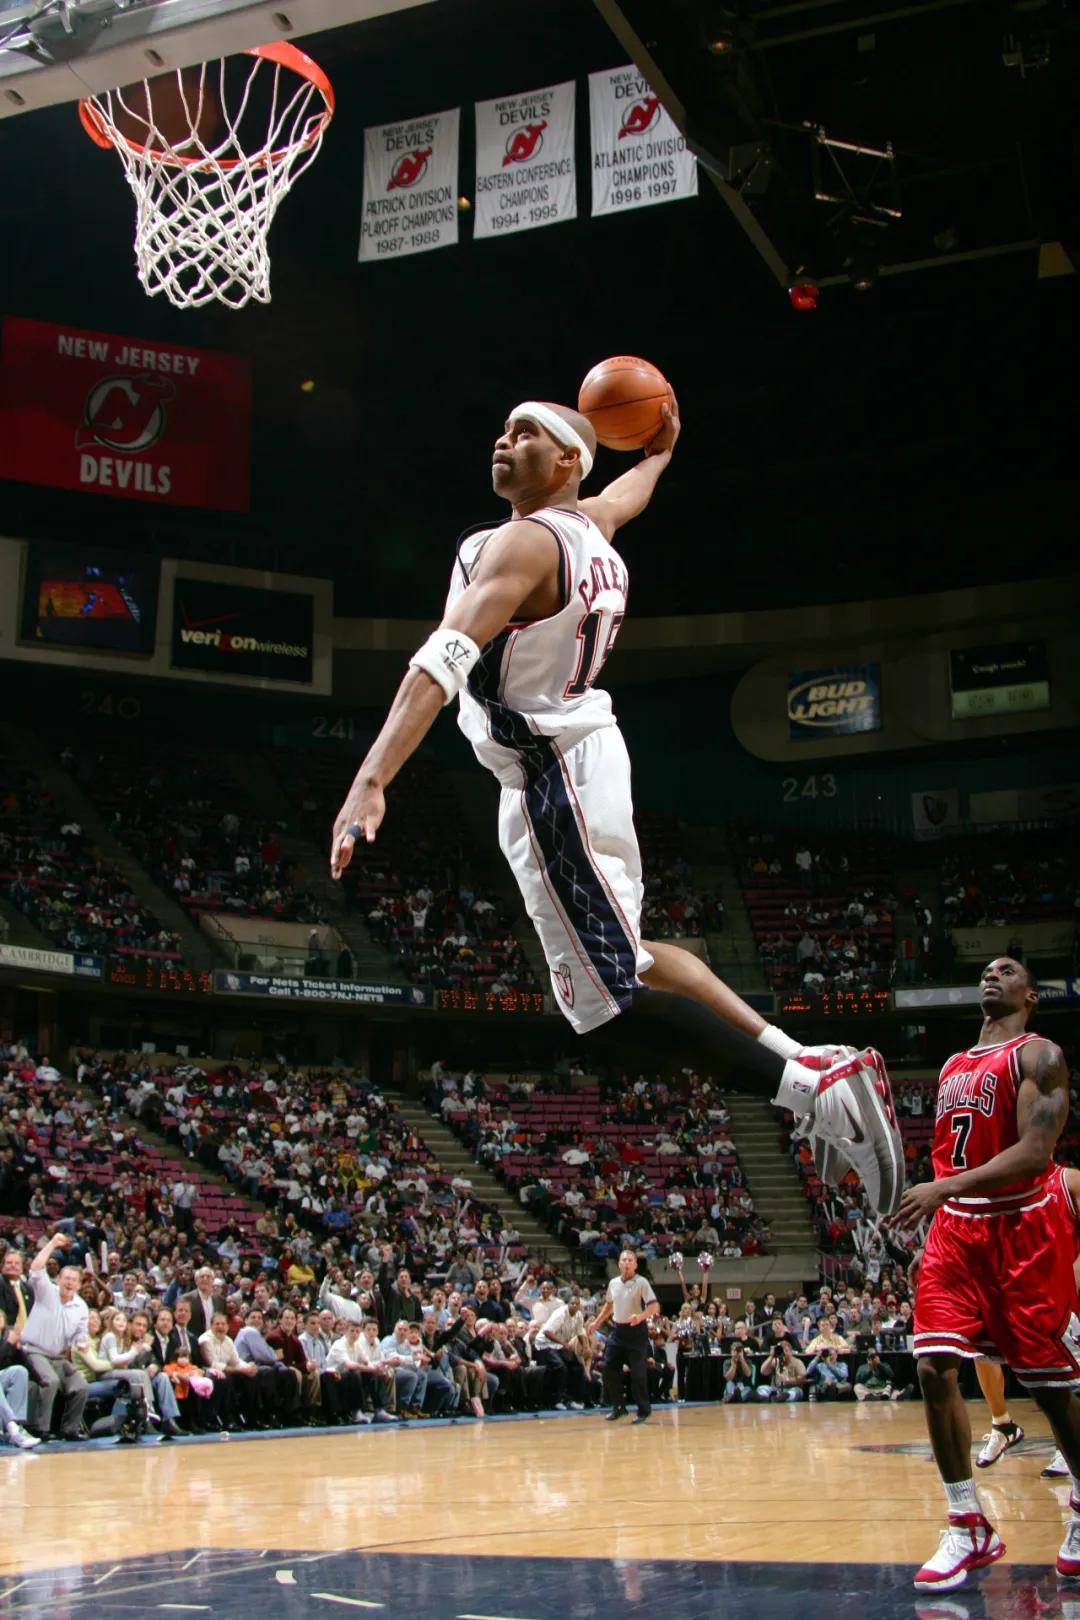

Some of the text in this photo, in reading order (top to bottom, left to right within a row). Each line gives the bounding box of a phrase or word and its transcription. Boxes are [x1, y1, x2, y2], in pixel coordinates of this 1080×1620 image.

[610, 73, 632, 85] NEW
[615, 80, 654, 99] DEVI
[495, 91, 554, 111] NEW JERSEY
[499, 102, 550, 126] DEVILS
[382, 118, 440, 138] NEW JERSEY
[386, 129, 434, 152] DEVILS
[594, 136, 687, 169] ATLANTIC DIVISIO
[476, 157, 572, 193] EASTERN CONFERENCE
[612, 160, 675, 187] CHAMPIONS
[366, 186, 452, 216] PATRICK DIVISION
[499, 185, 549, 210] CHAMPIONS
[361, 205, 454, 238] PLAYOFF CHAMPIONS
[58, 334, 200, 376] NEW JERSEY
[79, 454, 171, 494] DEVILS
[257, 638, 308, 658] wireless
[807, 680, 867, 702] BUD
[794, 695, 875, 720] LIGHT
[782, 772, 838, 802] 243
[250, 975, 402, 995] For Nets Ticket Information
[268, 986, 292, 997] Call
[936, 1071, 998, 1120] BULLS
[951, 1112, 973, 1169] 7
